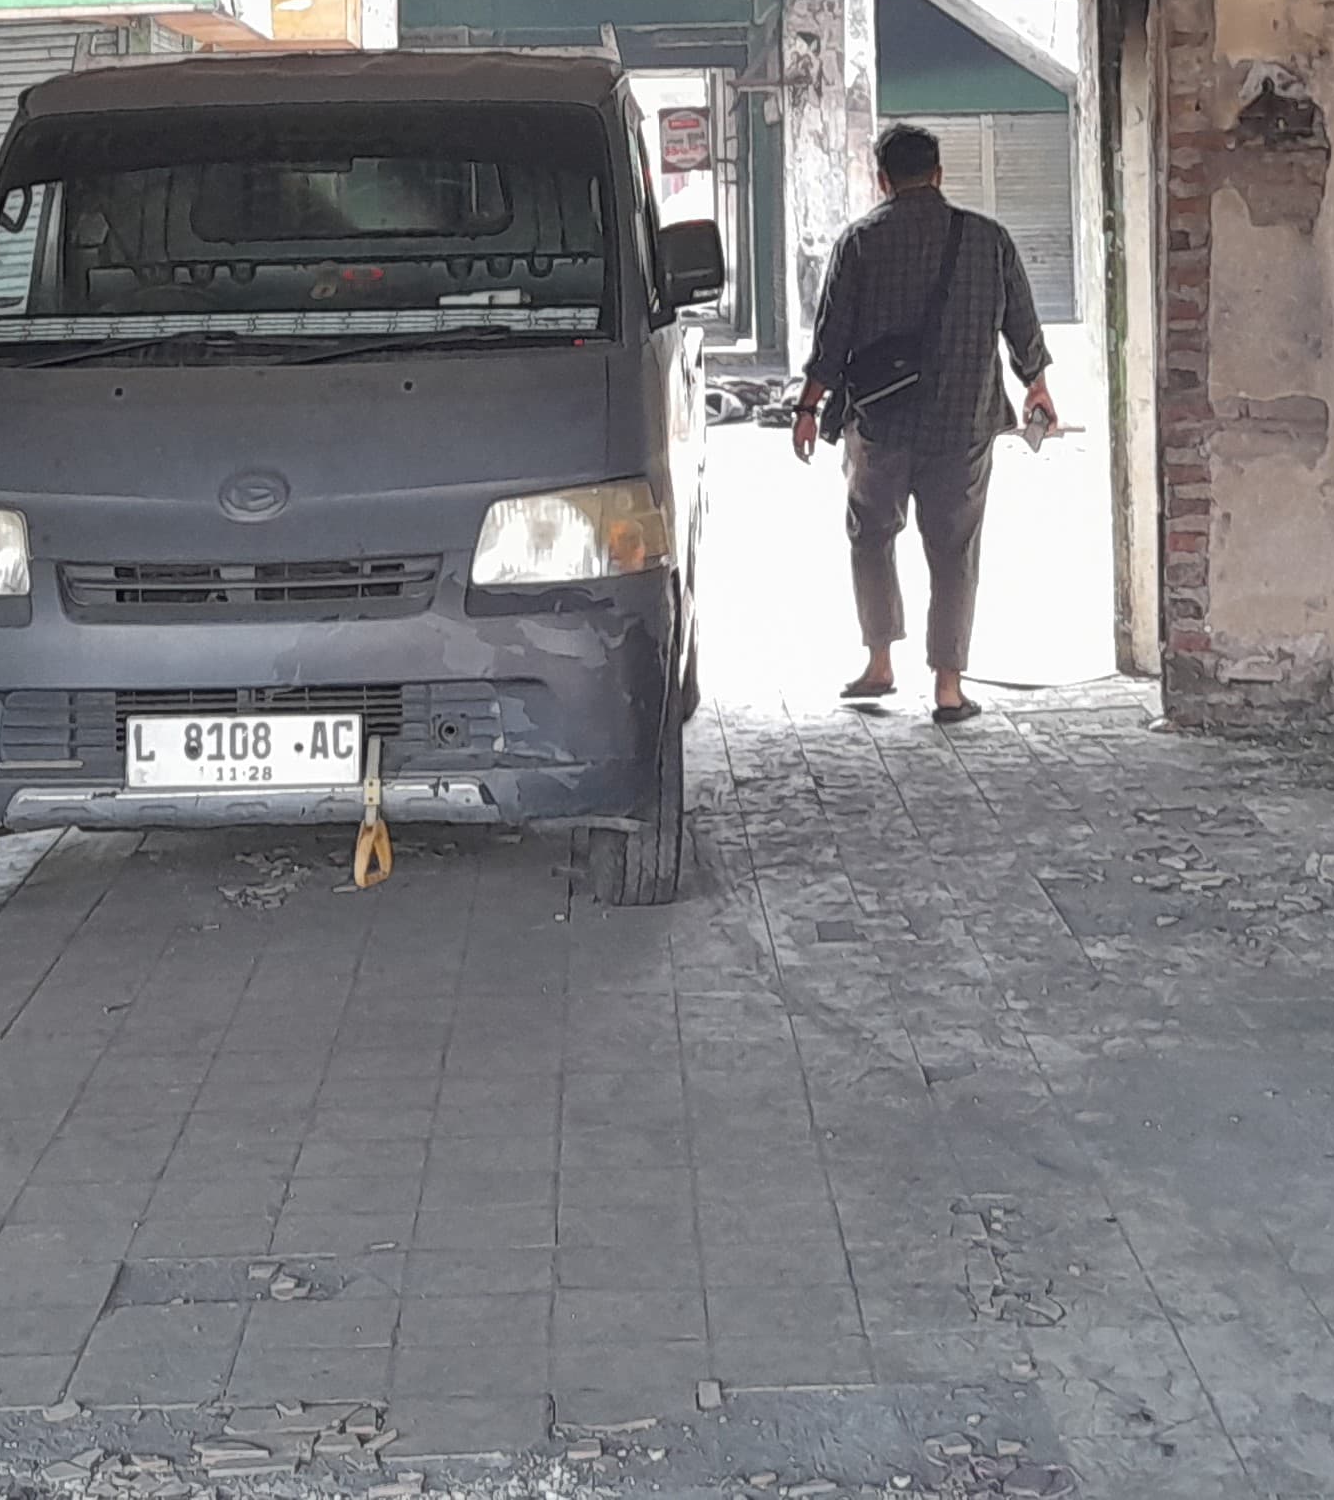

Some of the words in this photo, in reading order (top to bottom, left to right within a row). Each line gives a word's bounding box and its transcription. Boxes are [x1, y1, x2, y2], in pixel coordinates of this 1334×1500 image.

[133, 723, 155, 762] L
[184, 721, 272, 760] 8108
[309, 720, 354, 759] AC
